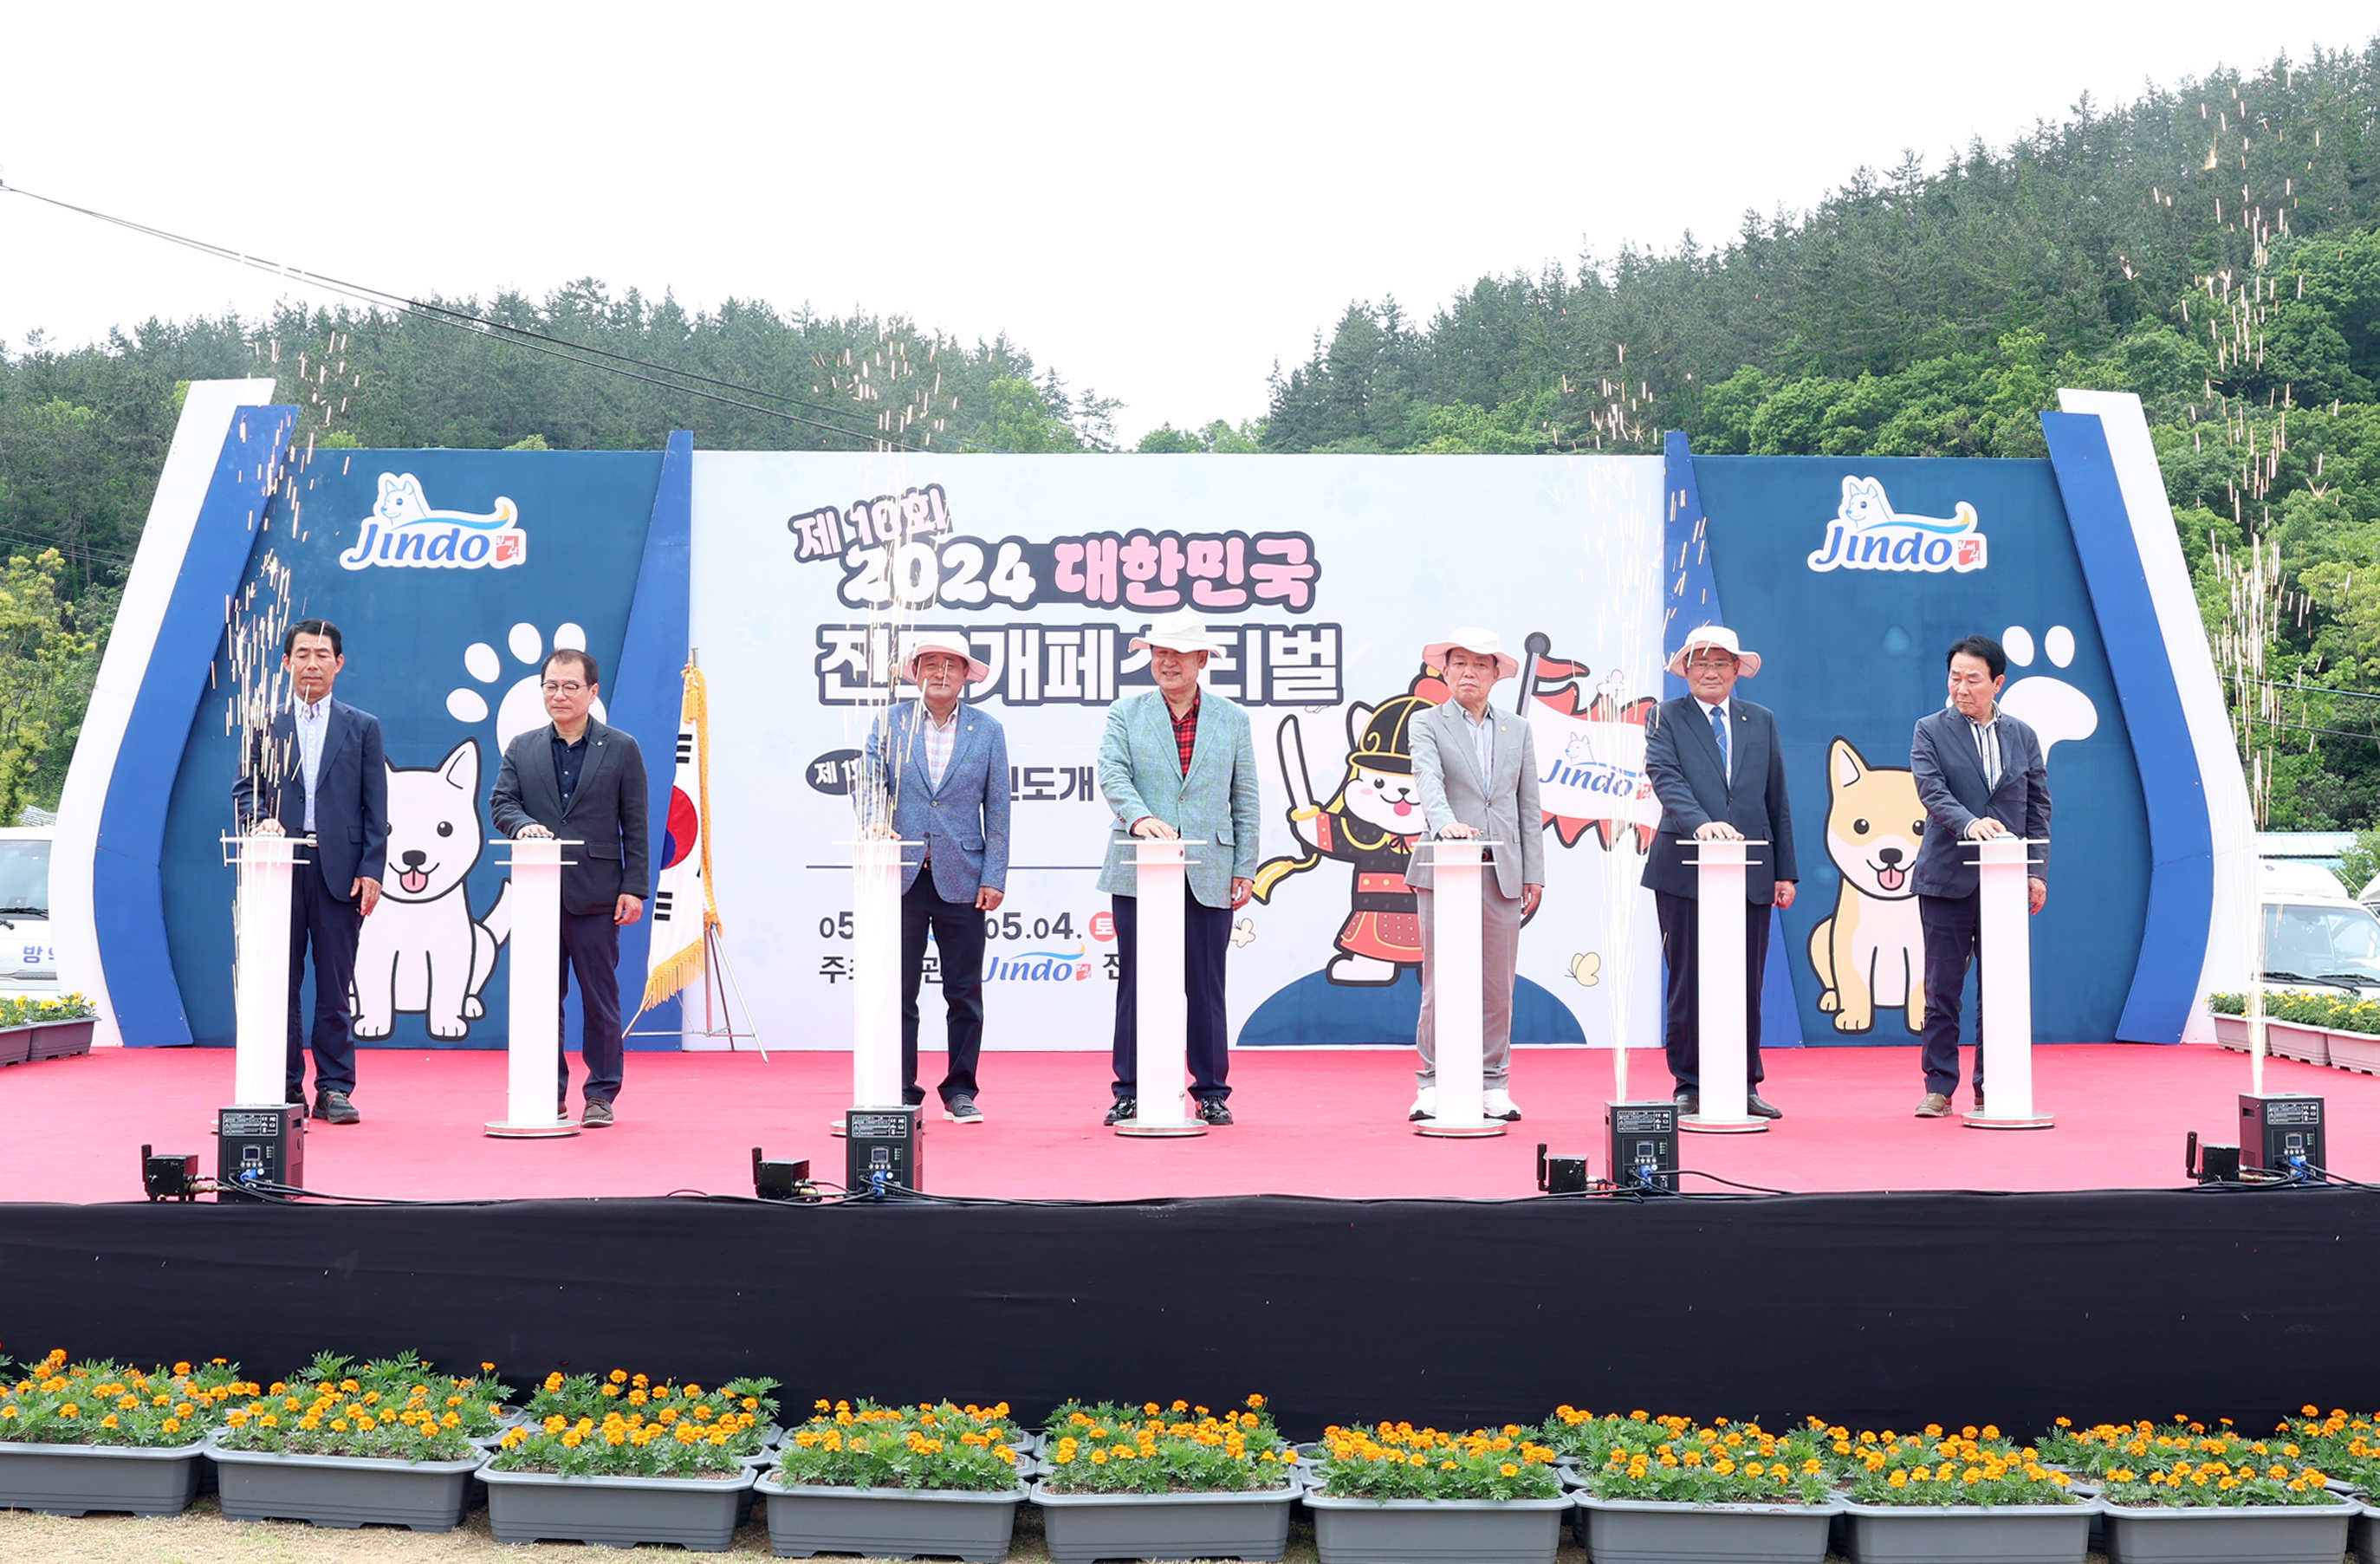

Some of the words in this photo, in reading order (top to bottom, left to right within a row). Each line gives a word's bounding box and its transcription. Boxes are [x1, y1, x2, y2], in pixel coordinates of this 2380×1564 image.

[793, 510, 842, 558] 제
[850, 487, 947, 546] 10회
[347, 523, 490, 563] Jindo
[1815, 526, 1953, 566] Jindo
[843, 541, 1036, 604] 2024
[1054, 535, 1314, 607] 대한민국
[814, 760, 838, 784] 제
[1538, 758, 1633, 797] Jindo
[1095, 918, 1114, 935] 토
[982, 957, 1073, 983] Jindo
